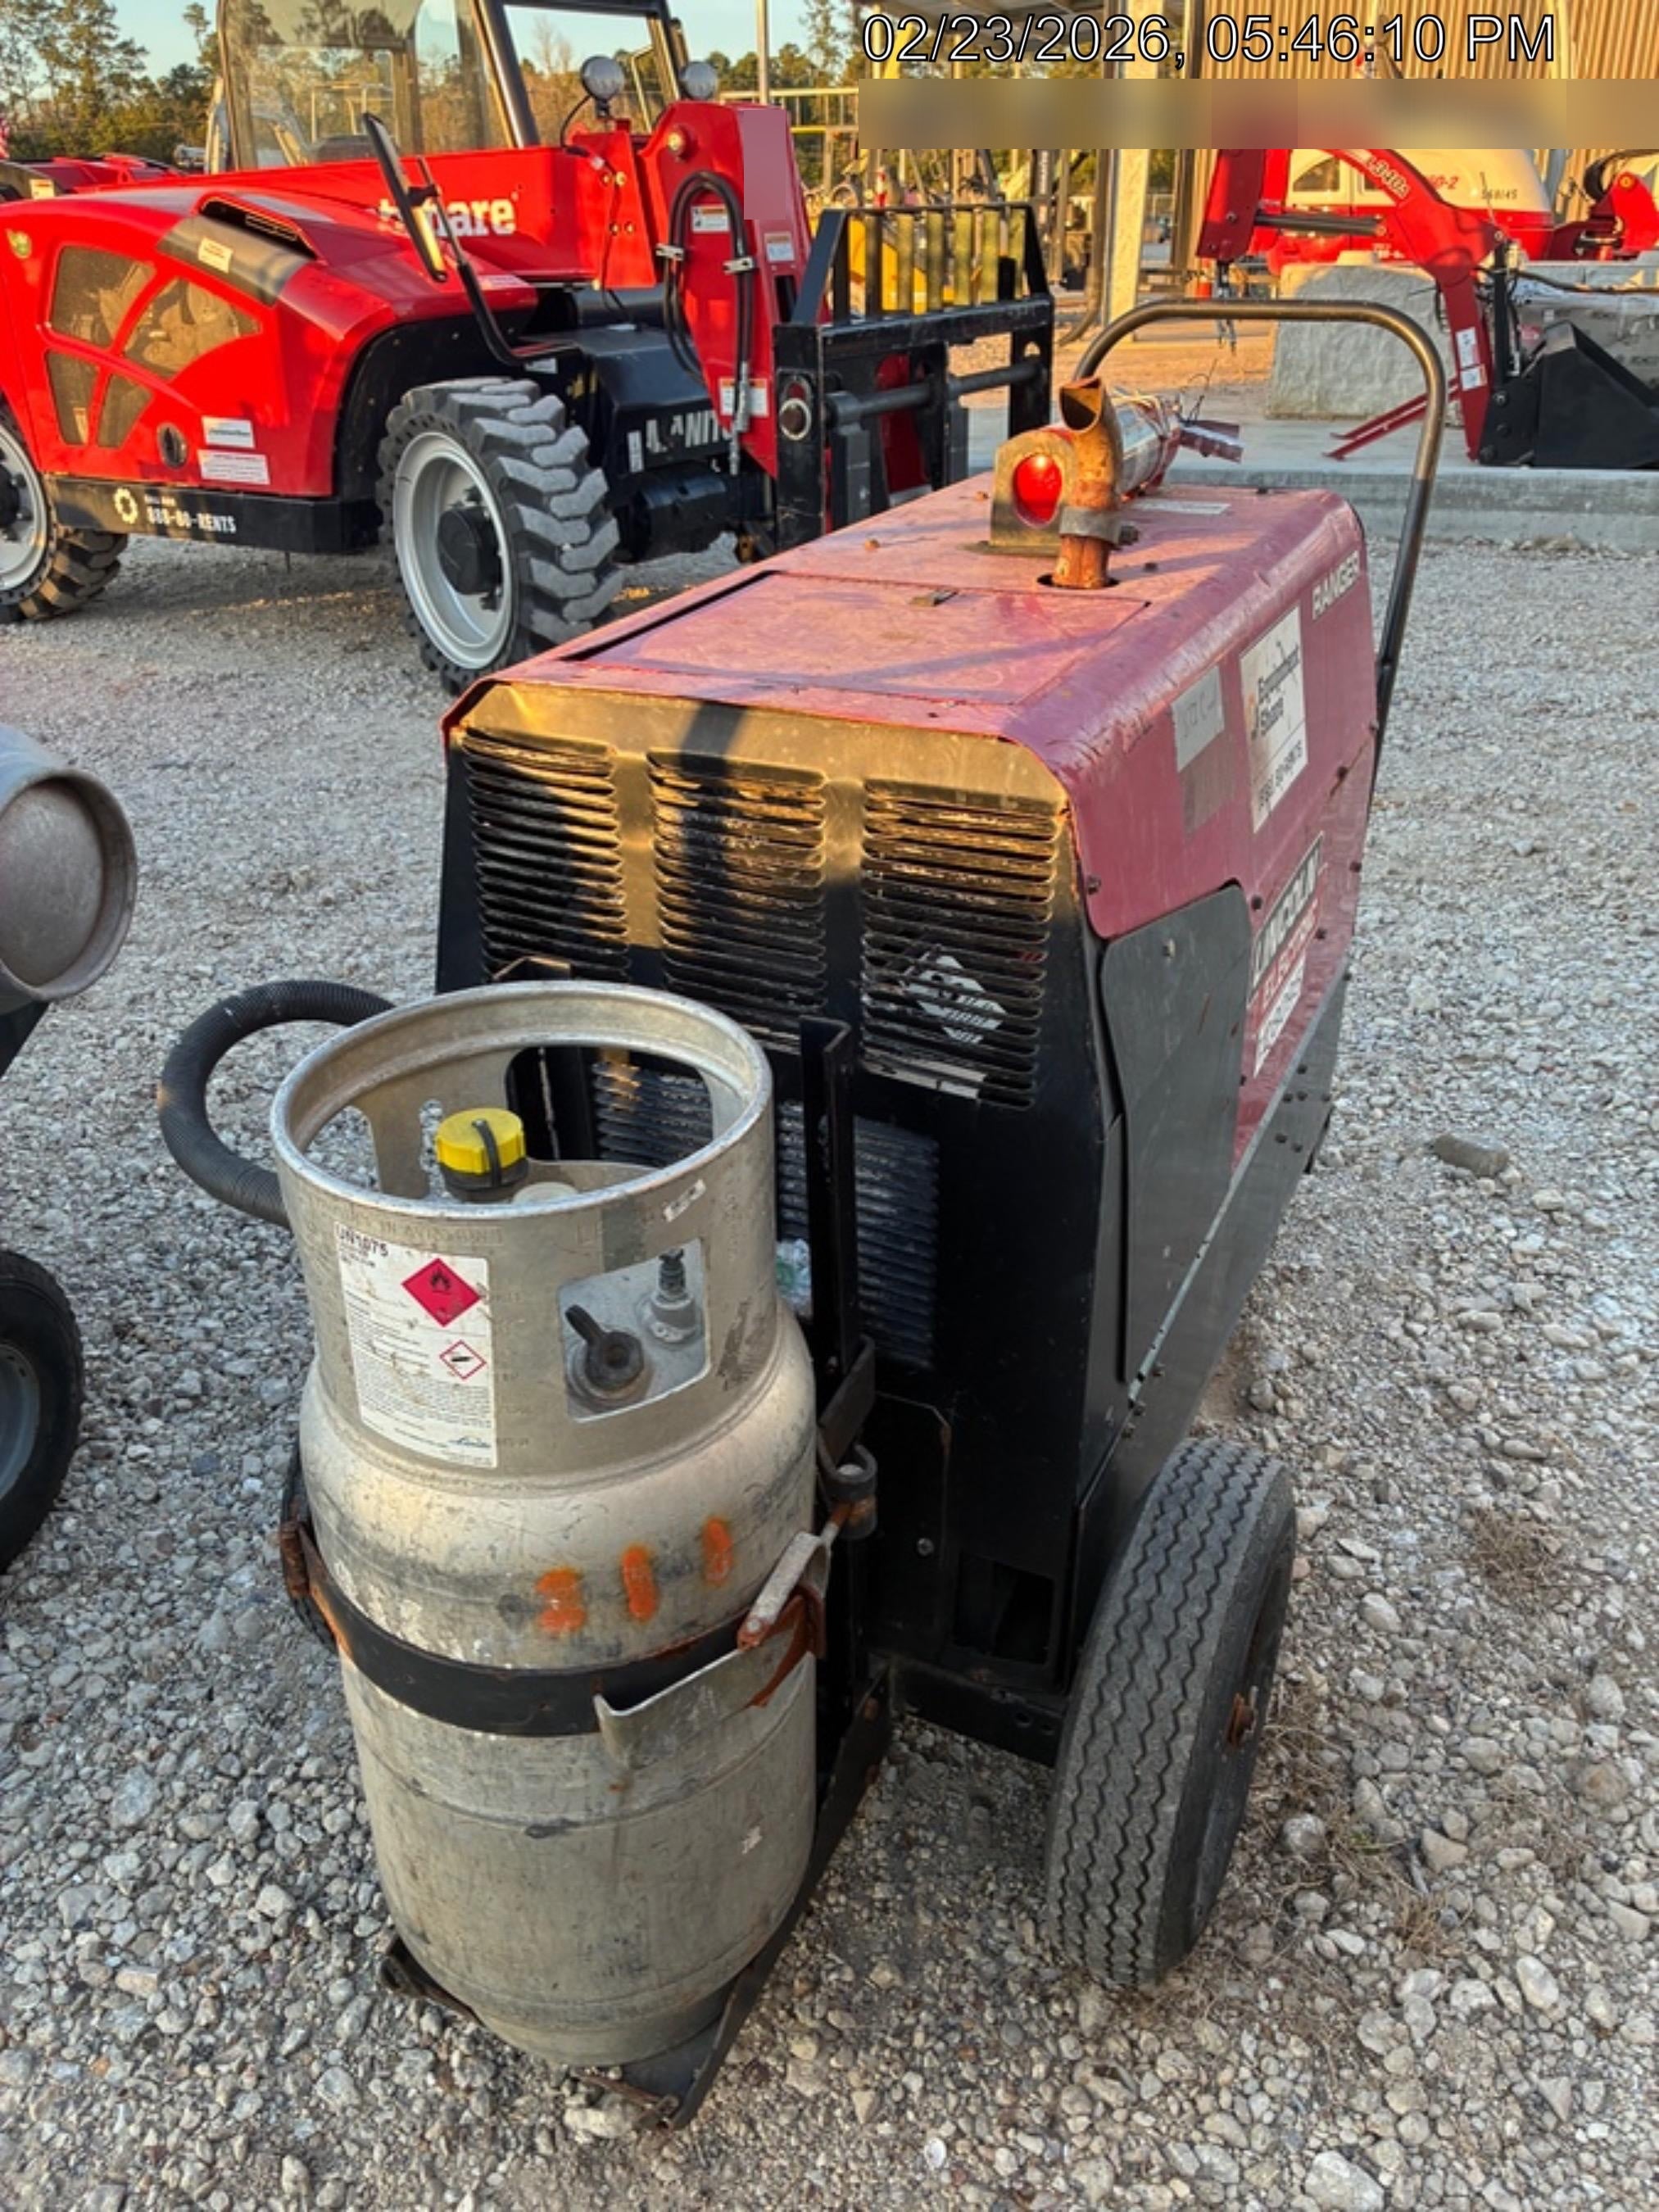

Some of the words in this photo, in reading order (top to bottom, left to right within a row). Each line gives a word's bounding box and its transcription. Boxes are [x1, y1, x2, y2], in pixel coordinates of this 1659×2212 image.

[1311, 549, 1361, 620] RANGER
[1253, 847, 1320, 988] LINCOLN
[337, 1221, 389, 1258] UN1075
